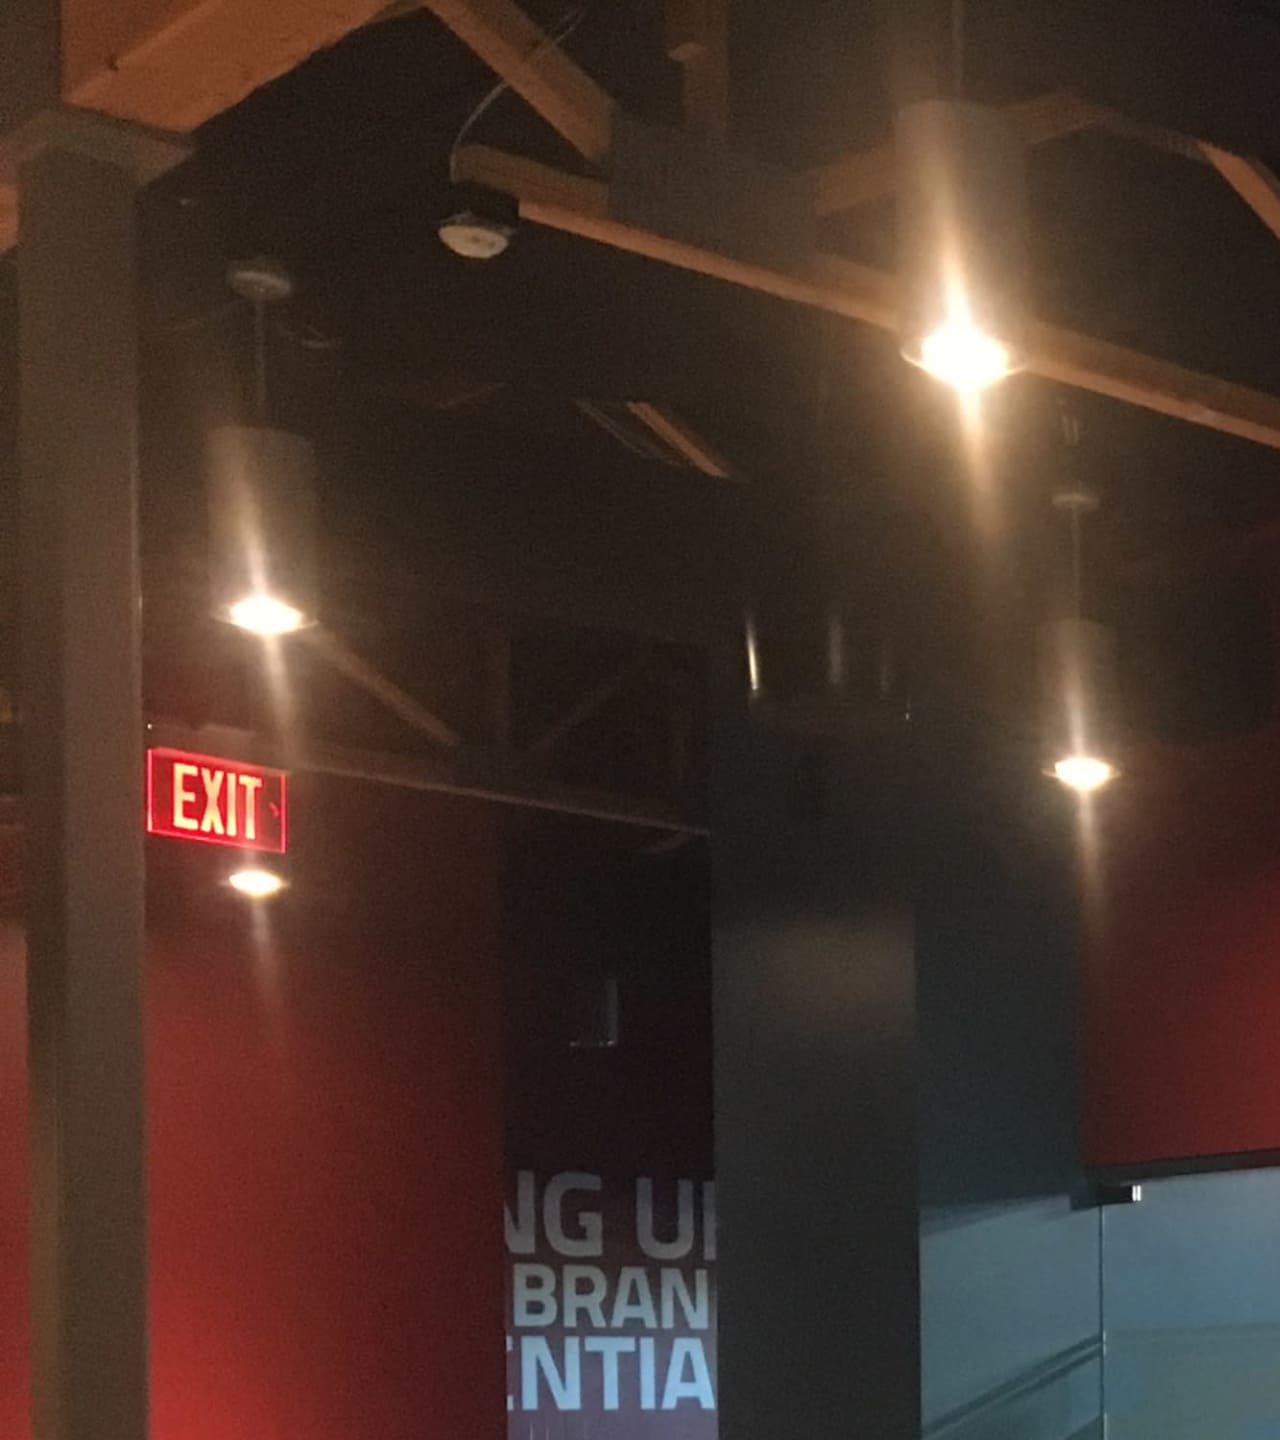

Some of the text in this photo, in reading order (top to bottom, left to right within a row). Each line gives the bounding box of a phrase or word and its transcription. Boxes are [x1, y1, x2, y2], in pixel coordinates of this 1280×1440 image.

[173, 763, 262, 840] EXIT
[636, 1177, 716, 1261] U
[513, 1263, 709, 1330] BRAN
[506, 1335, 716, 1411] NTIA
